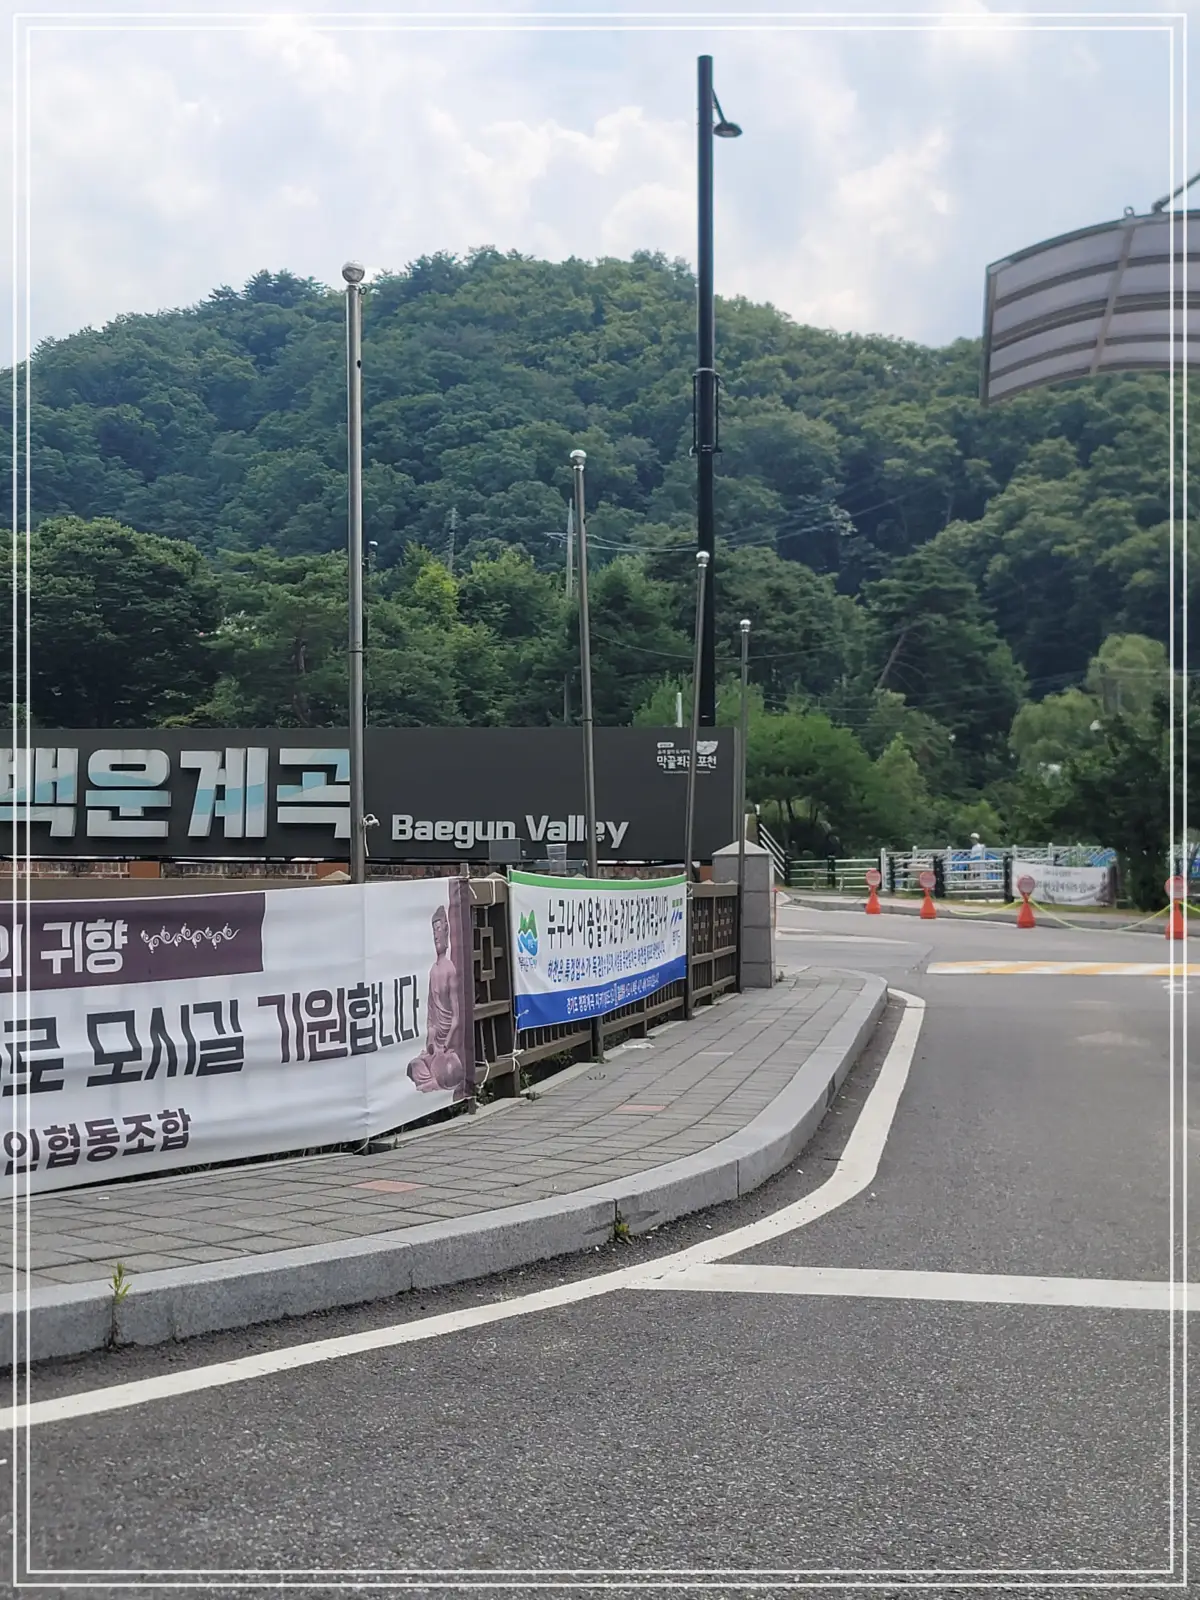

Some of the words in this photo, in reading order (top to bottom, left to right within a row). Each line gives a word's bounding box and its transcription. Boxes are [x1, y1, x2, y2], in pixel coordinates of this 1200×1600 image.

[696, 755, 717, 769] 포천
[0, 747, 351, 838] 백운계곡
[391, 814, 516, 849] Baegun
[525, 814, 629, 849] Valley
[40, 918, 128, 975] 귀향
[547, 898, 575, 949] 누구나
[0, 1016, 65, 1097] 로
[86, 998, 245, 1088] 모시길
[257, 974, 420, 1064] 기원합니다
[4, 1107, 192, 1176] 인협동조합
